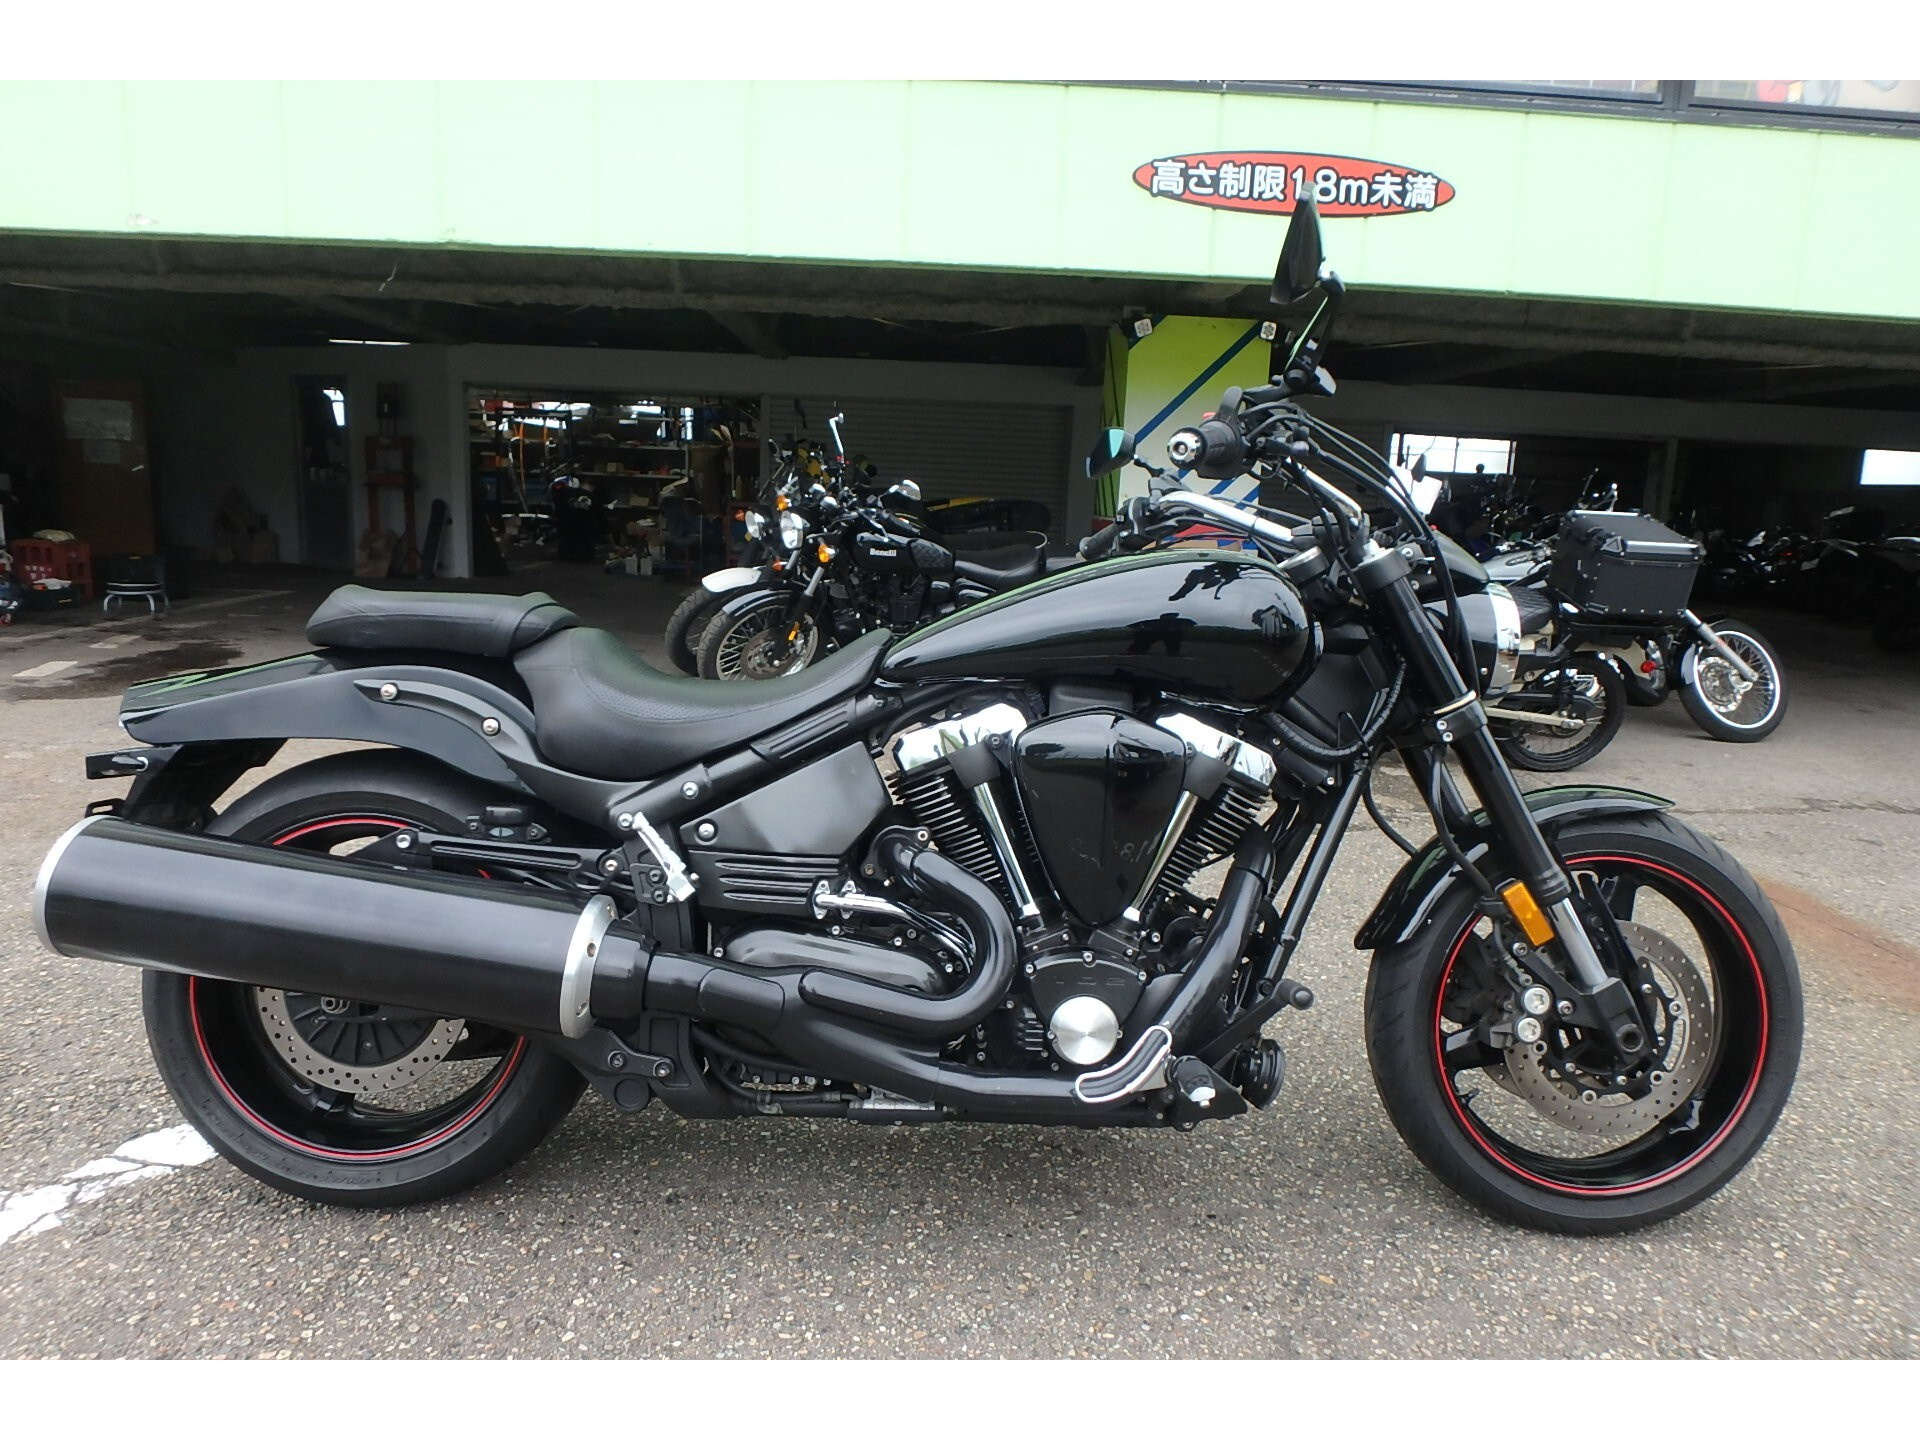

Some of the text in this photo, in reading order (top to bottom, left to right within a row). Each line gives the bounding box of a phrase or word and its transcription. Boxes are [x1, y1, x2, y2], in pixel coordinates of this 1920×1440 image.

[1151, 159, 1438, 210] 高さ制限18m未満
